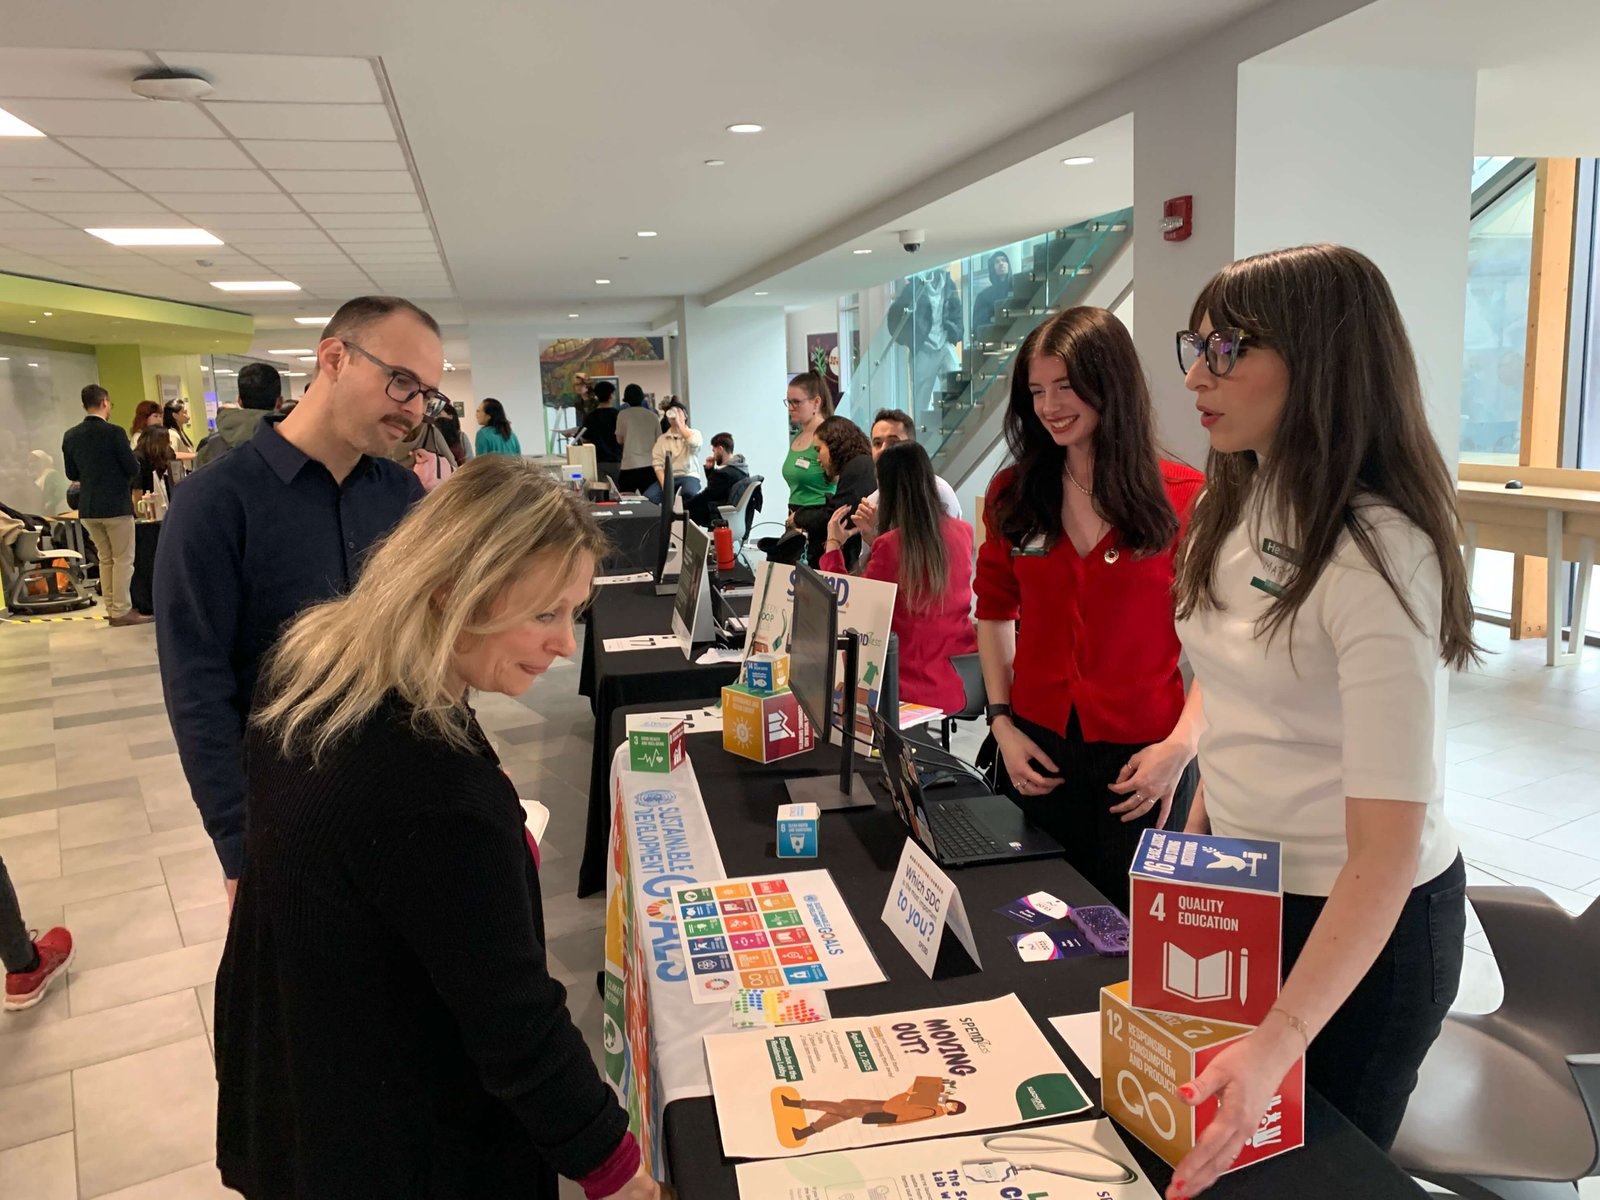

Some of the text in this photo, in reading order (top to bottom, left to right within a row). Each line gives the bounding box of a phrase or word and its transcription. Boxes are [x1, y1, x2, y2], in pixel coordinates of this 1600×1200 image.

[633, 735, 639, 745] 3
[658, 806, 695, 872] SUSTAINABLE
[1143, 861, 1175, 875] 16
[905, 863, 941, 913] Which SDG
[1149, 892, 1166, 921] 4
[1178, 895, 1224, 914] QUALITY
[897, 888, 935, 942] to you?
[1178, 911, 1239, 931] EDUCATION
[818, 927, 844, 955] GOALS
[1106, 1008, 1123, 1041] 12
[1183, 1025, 1213, 1039] 2
[848, 1032, 862, 1044] April
[891, 1022, 930, 1054] OUT?
[923, 1018, 977, 1076] MOVING
[1128, 1022, 1173, 1063] RESPONSIBLE
[774, 1061, 788, 1076] Lobby
[784, 1055, 793, 1064] box
[1128, 1037, 1176, 1081] CONSUMPTION
[1129, 1052, 1143, 1071] AND
[788, 1070, 798, 1079] the
[932, 1171, 946, 1187] Lab
[946, 1169, 960, 1187] The
[1000, 1186, 1022, 1200] C
